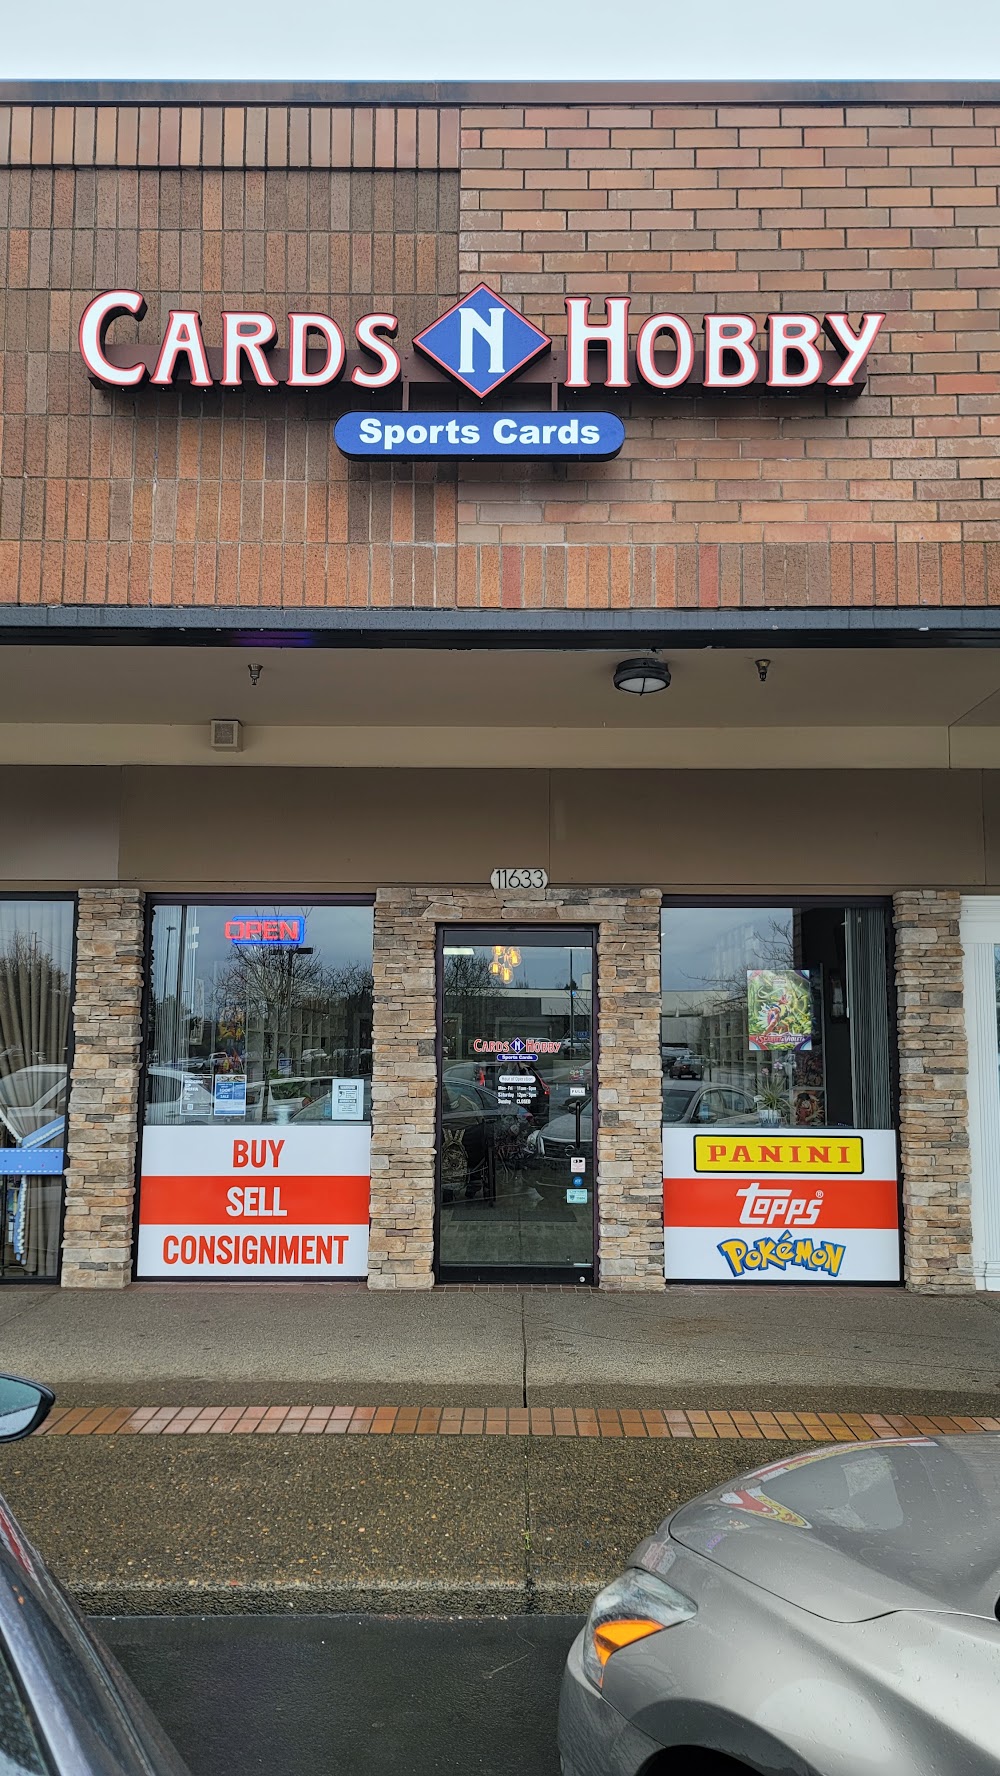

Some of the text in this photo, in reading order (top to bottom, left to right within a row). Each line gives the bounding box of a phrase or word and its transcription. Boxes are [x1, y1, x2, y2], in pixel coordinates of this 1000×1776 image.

[79, 289, 885, 388] CARDS N HOBBY
[358, 418, 601, 450] Sports Cards
[496, 869, 544, 889] 11633
[225, 921, 298, 940] OPEN
[232, 1139, 285, 1168] BUY
[706, 1145, 850, 1163] PANINI
[225, 1186, 288, 1217] SELL
[162, 1234, 349, 1265] CONSIGNMENT
